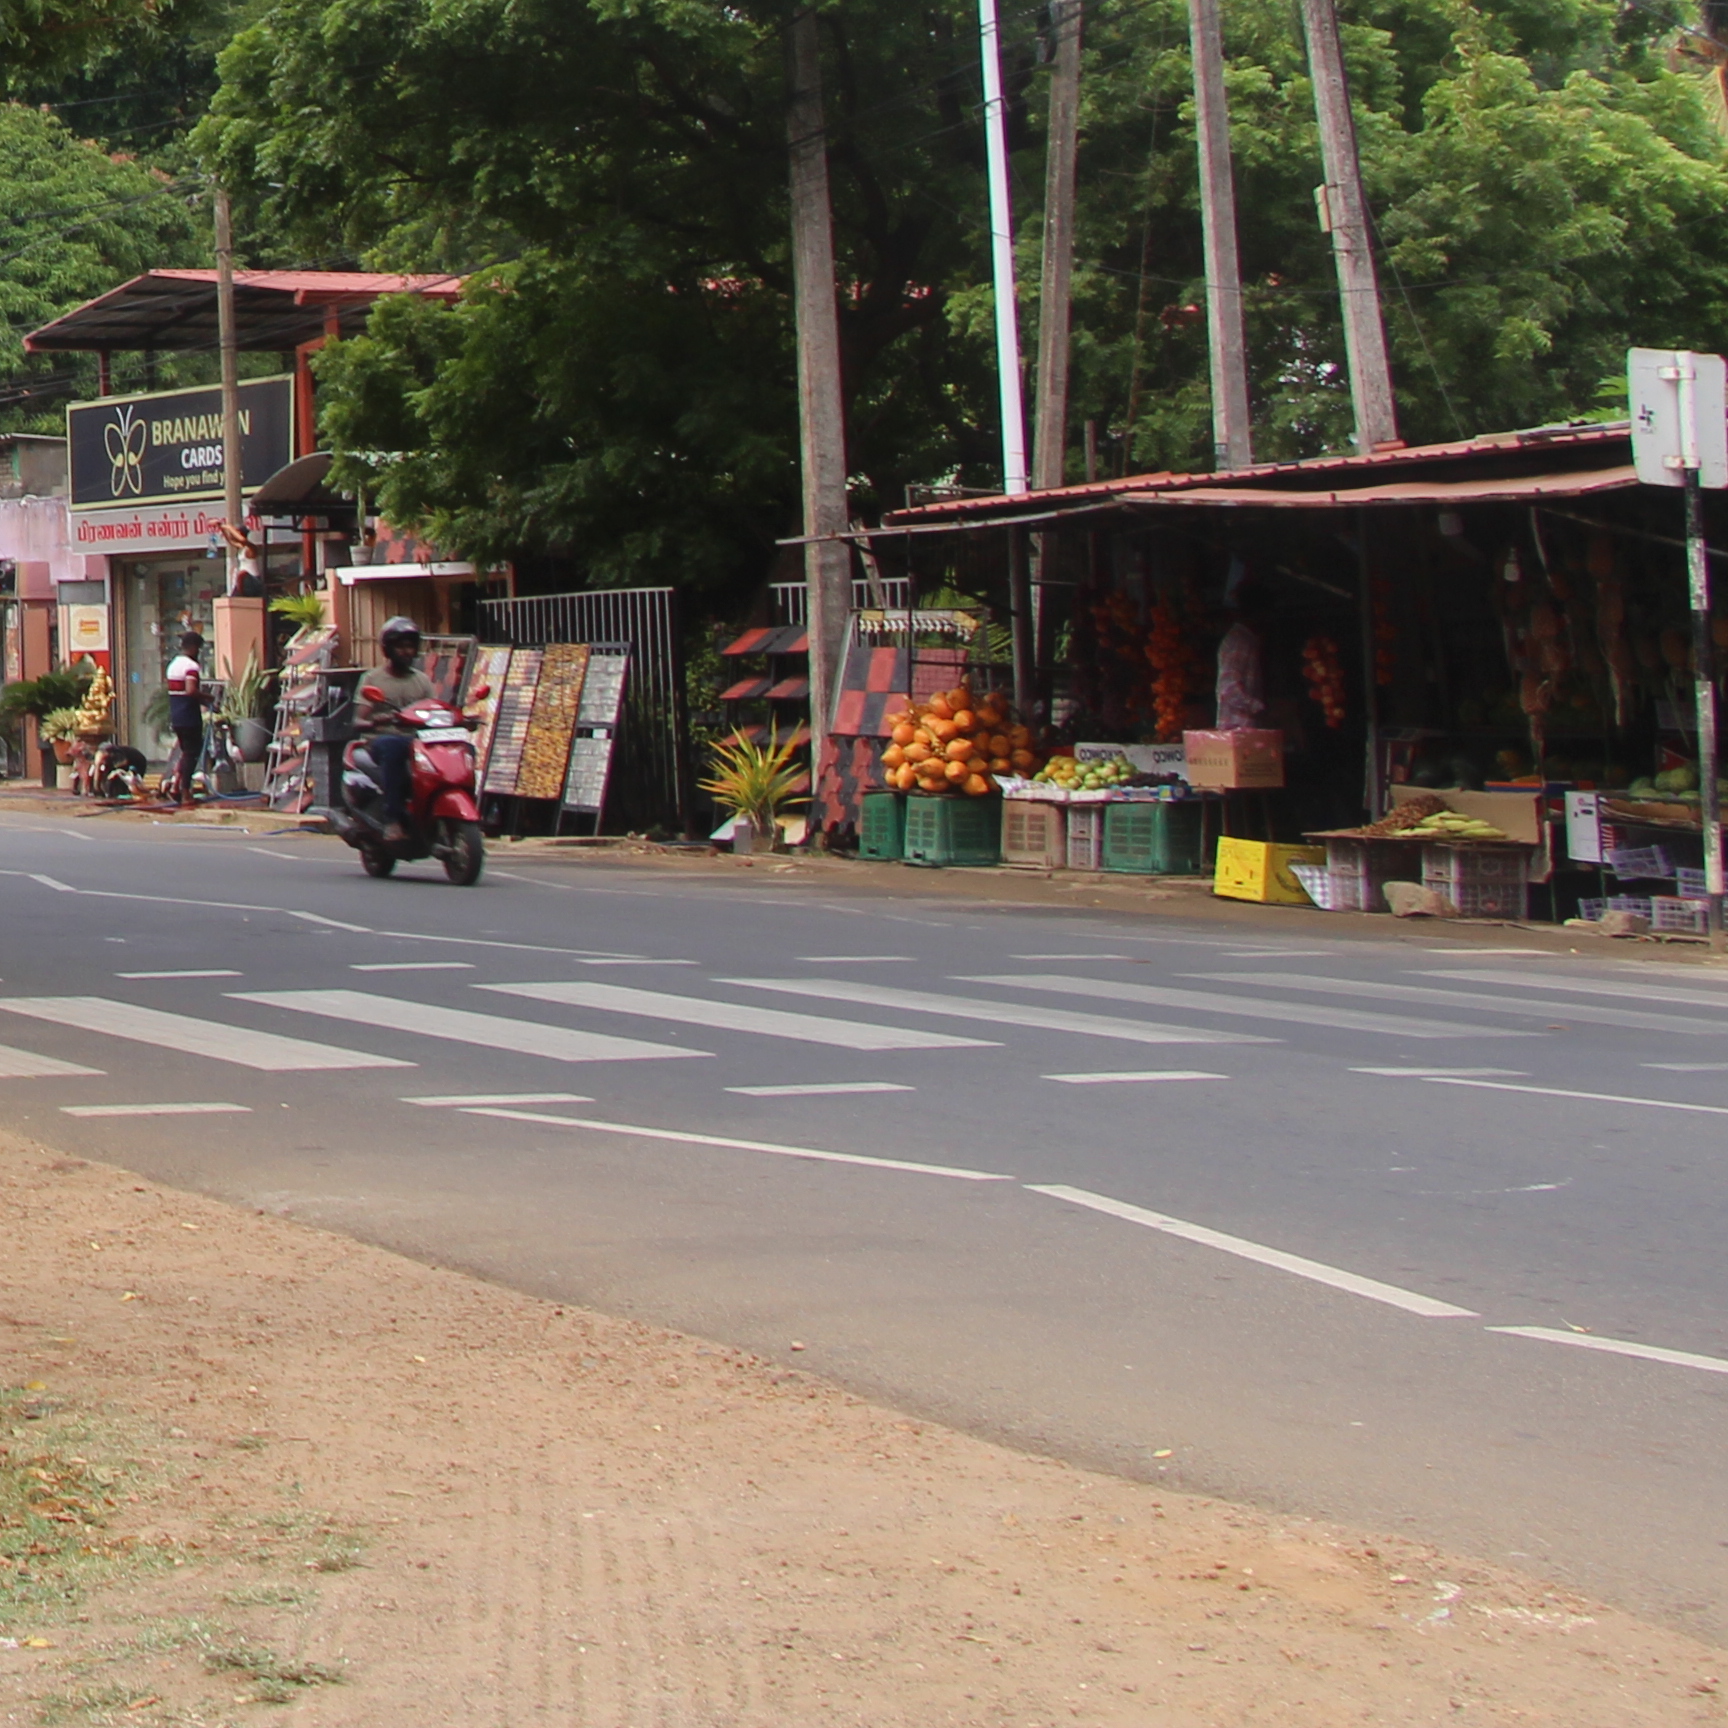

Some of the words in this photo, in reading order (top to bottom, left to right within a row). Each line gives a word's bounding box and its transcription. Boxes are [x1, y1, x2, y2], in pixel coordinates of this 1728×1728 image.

[151, 409, 250, 446] BRANAWN
[181, 445, 223, 469] CARDS
[185, 473, 201, 489] you
[202, 470, 219, 486] find
